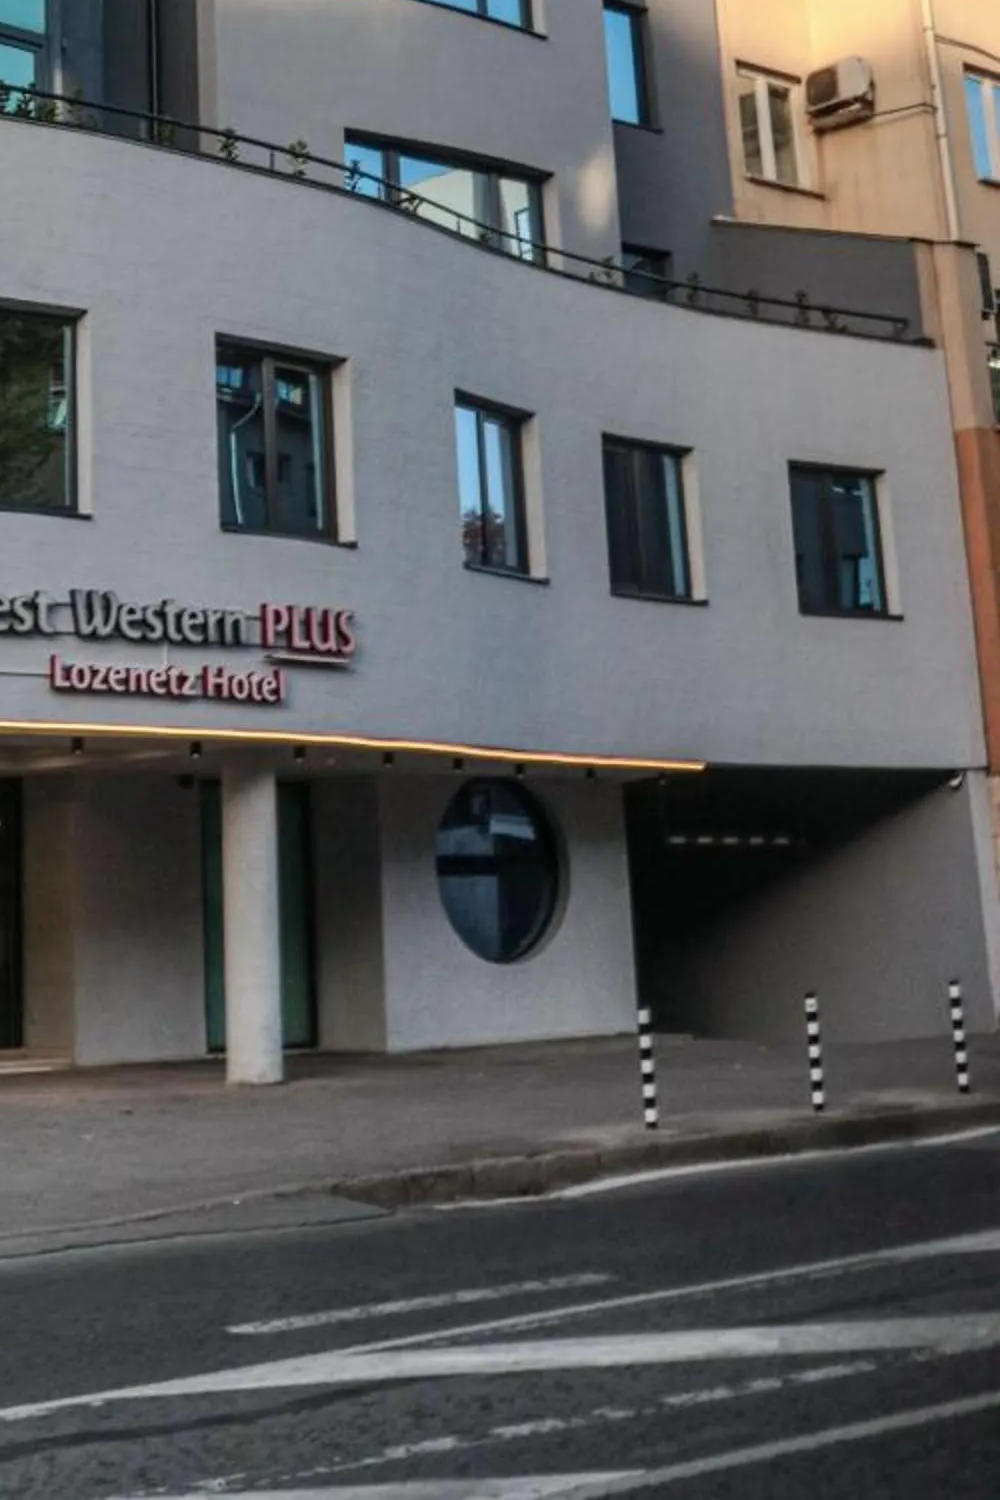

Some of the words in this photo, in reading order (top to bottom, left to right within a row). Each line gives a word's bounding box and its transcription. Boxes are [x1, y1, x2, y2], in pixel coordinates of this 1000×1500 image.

[71, 589, 246, 644] Western
[261, 603, 356, 655] PLUS
[51, 654, 198, 697] Lozenetz
[202, 665, 286, 702] Hotel
